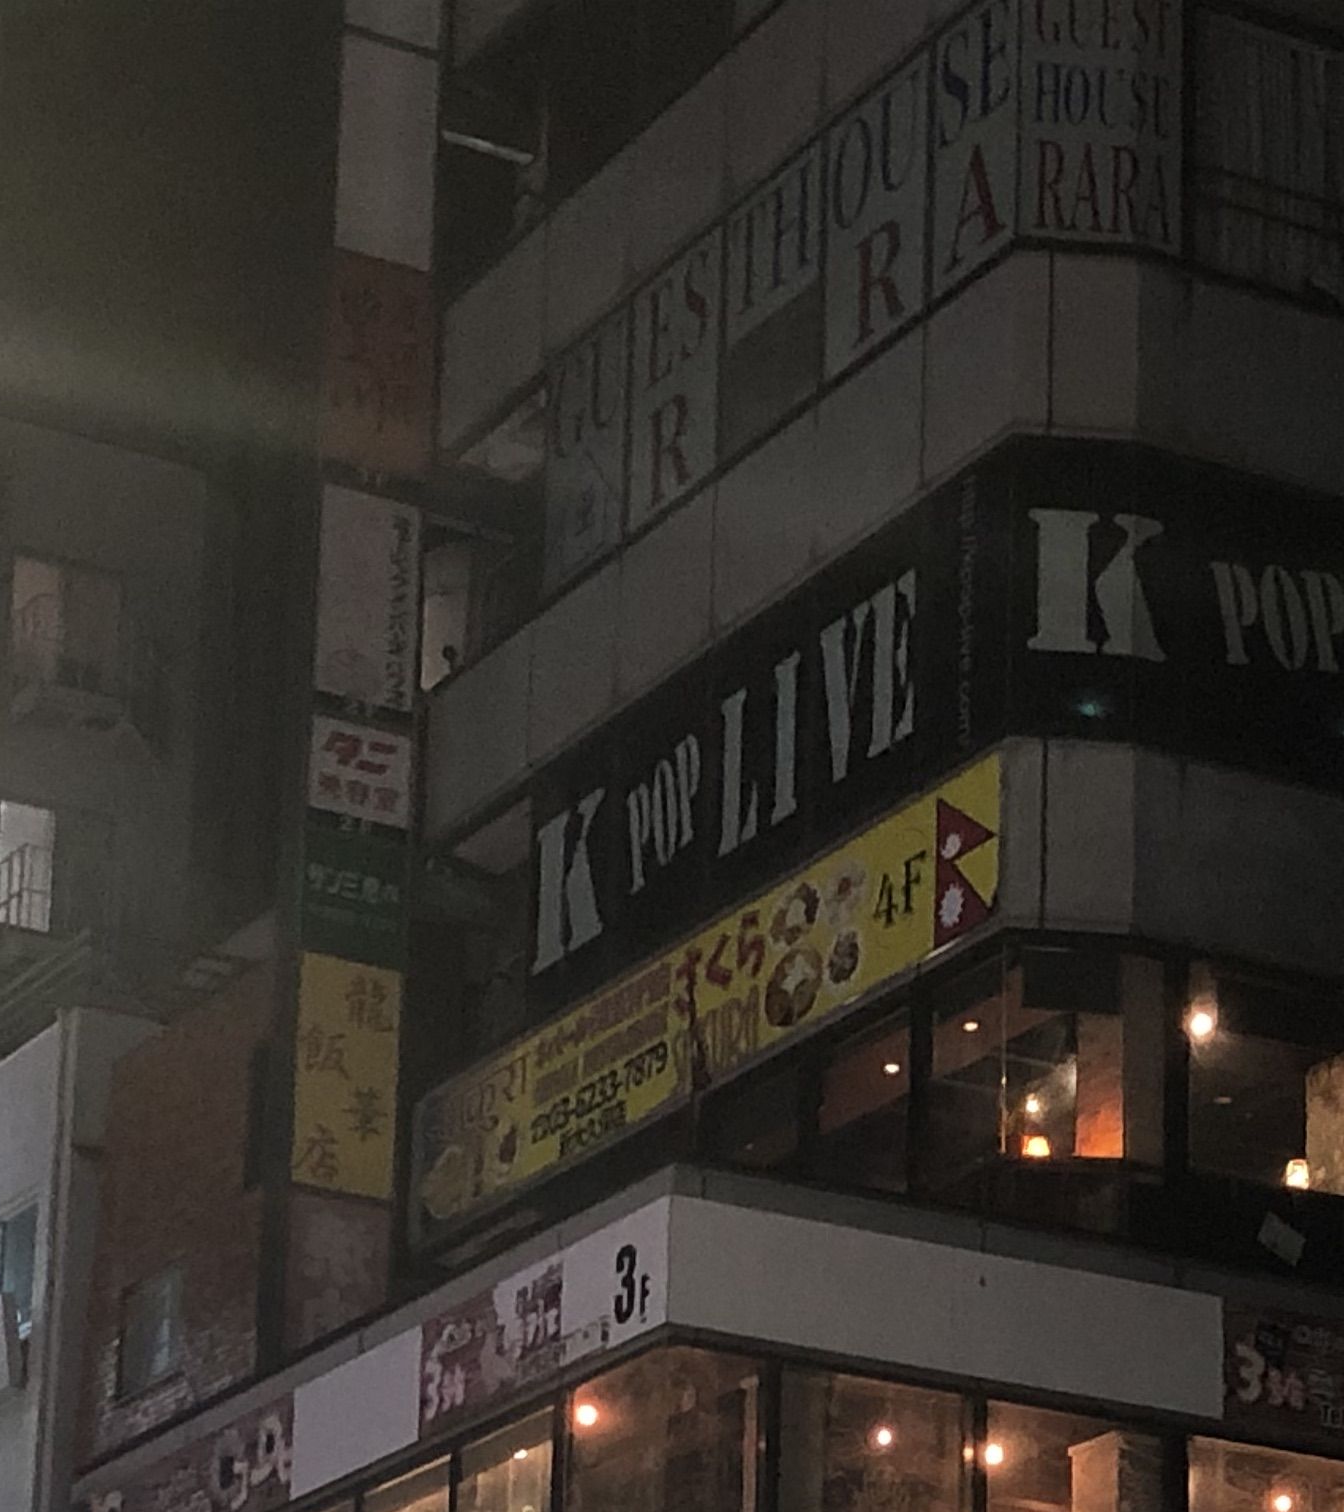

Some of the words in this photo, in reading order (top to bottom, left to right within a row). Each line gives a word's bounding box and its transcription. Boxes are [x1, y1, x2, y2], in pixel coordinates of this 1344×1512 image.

[1033, 61, 1172, 140] HOUSE
[1033, 139, 1174, 249] RARA
[1028, 507, 1165, 662] K
[531, 787, 604, 975] K
[626, 734, 701, 896] POP
[717, 570, 916, 857] LIVE
[872, 850, 928, 926] 4F
